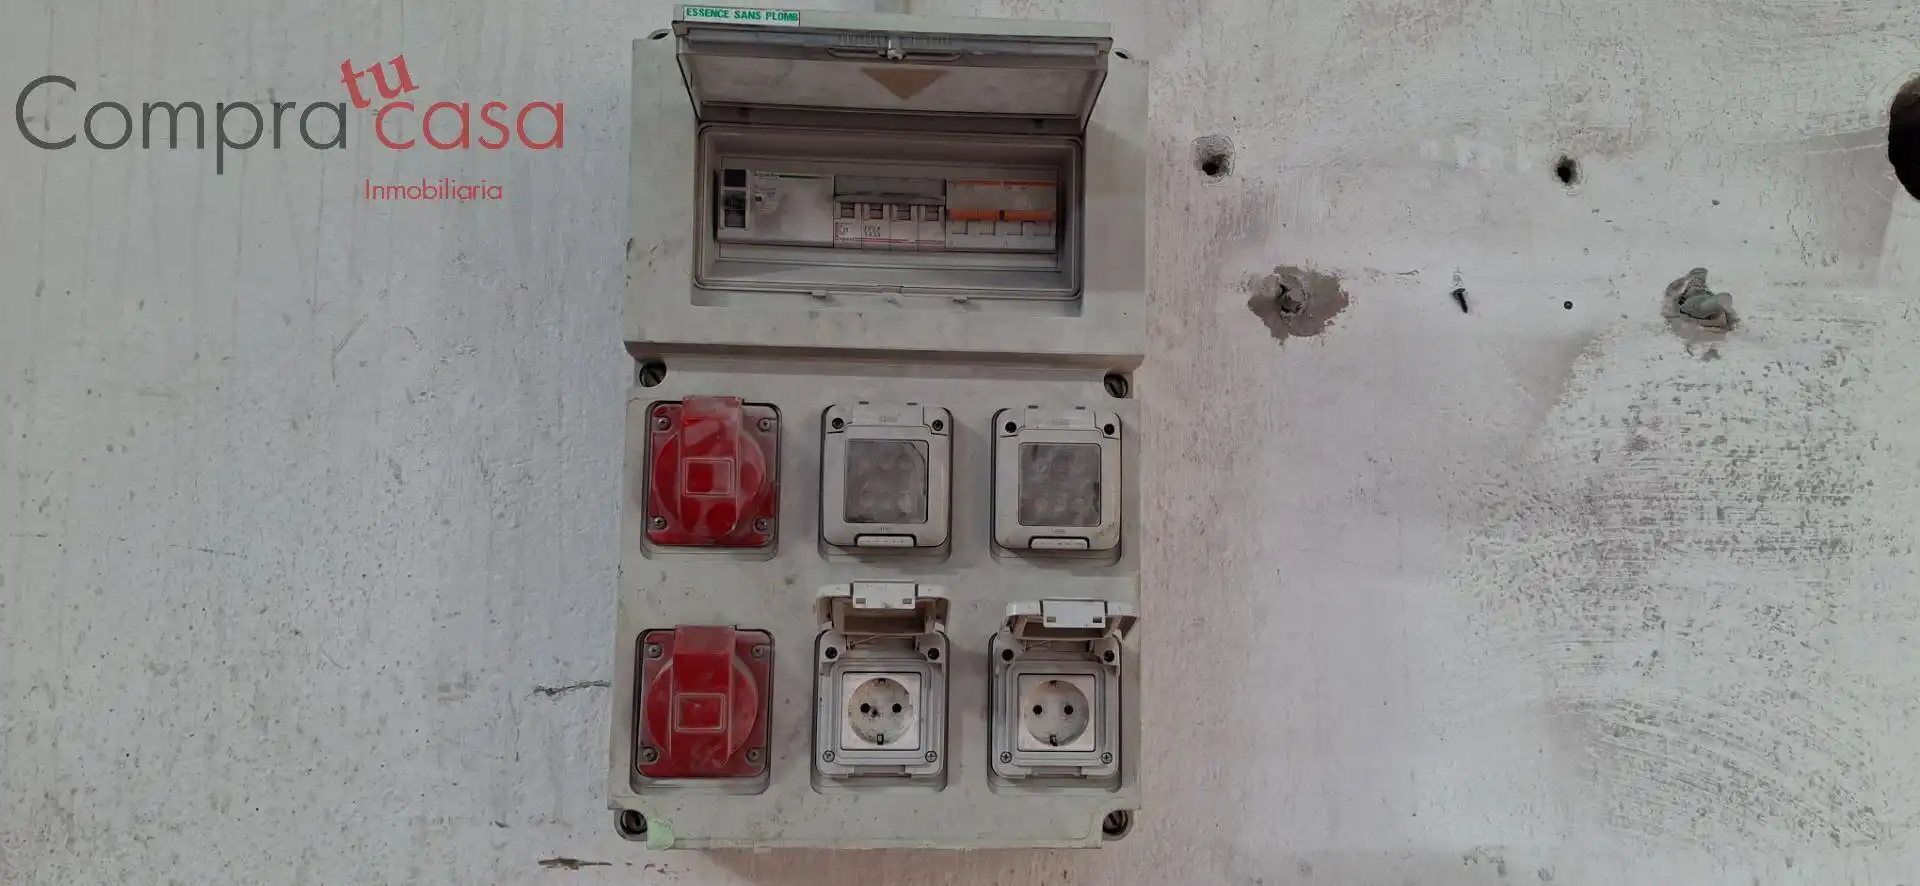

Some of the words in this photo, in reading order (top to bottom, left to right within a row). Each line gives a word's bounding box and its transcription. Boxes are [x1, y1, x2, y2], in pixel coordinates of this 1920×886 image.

[686, 8, 729, 18] ESSENCE
[734, 10, 761, 20] SANS
[766, 11, 798, 21] PLOMB
